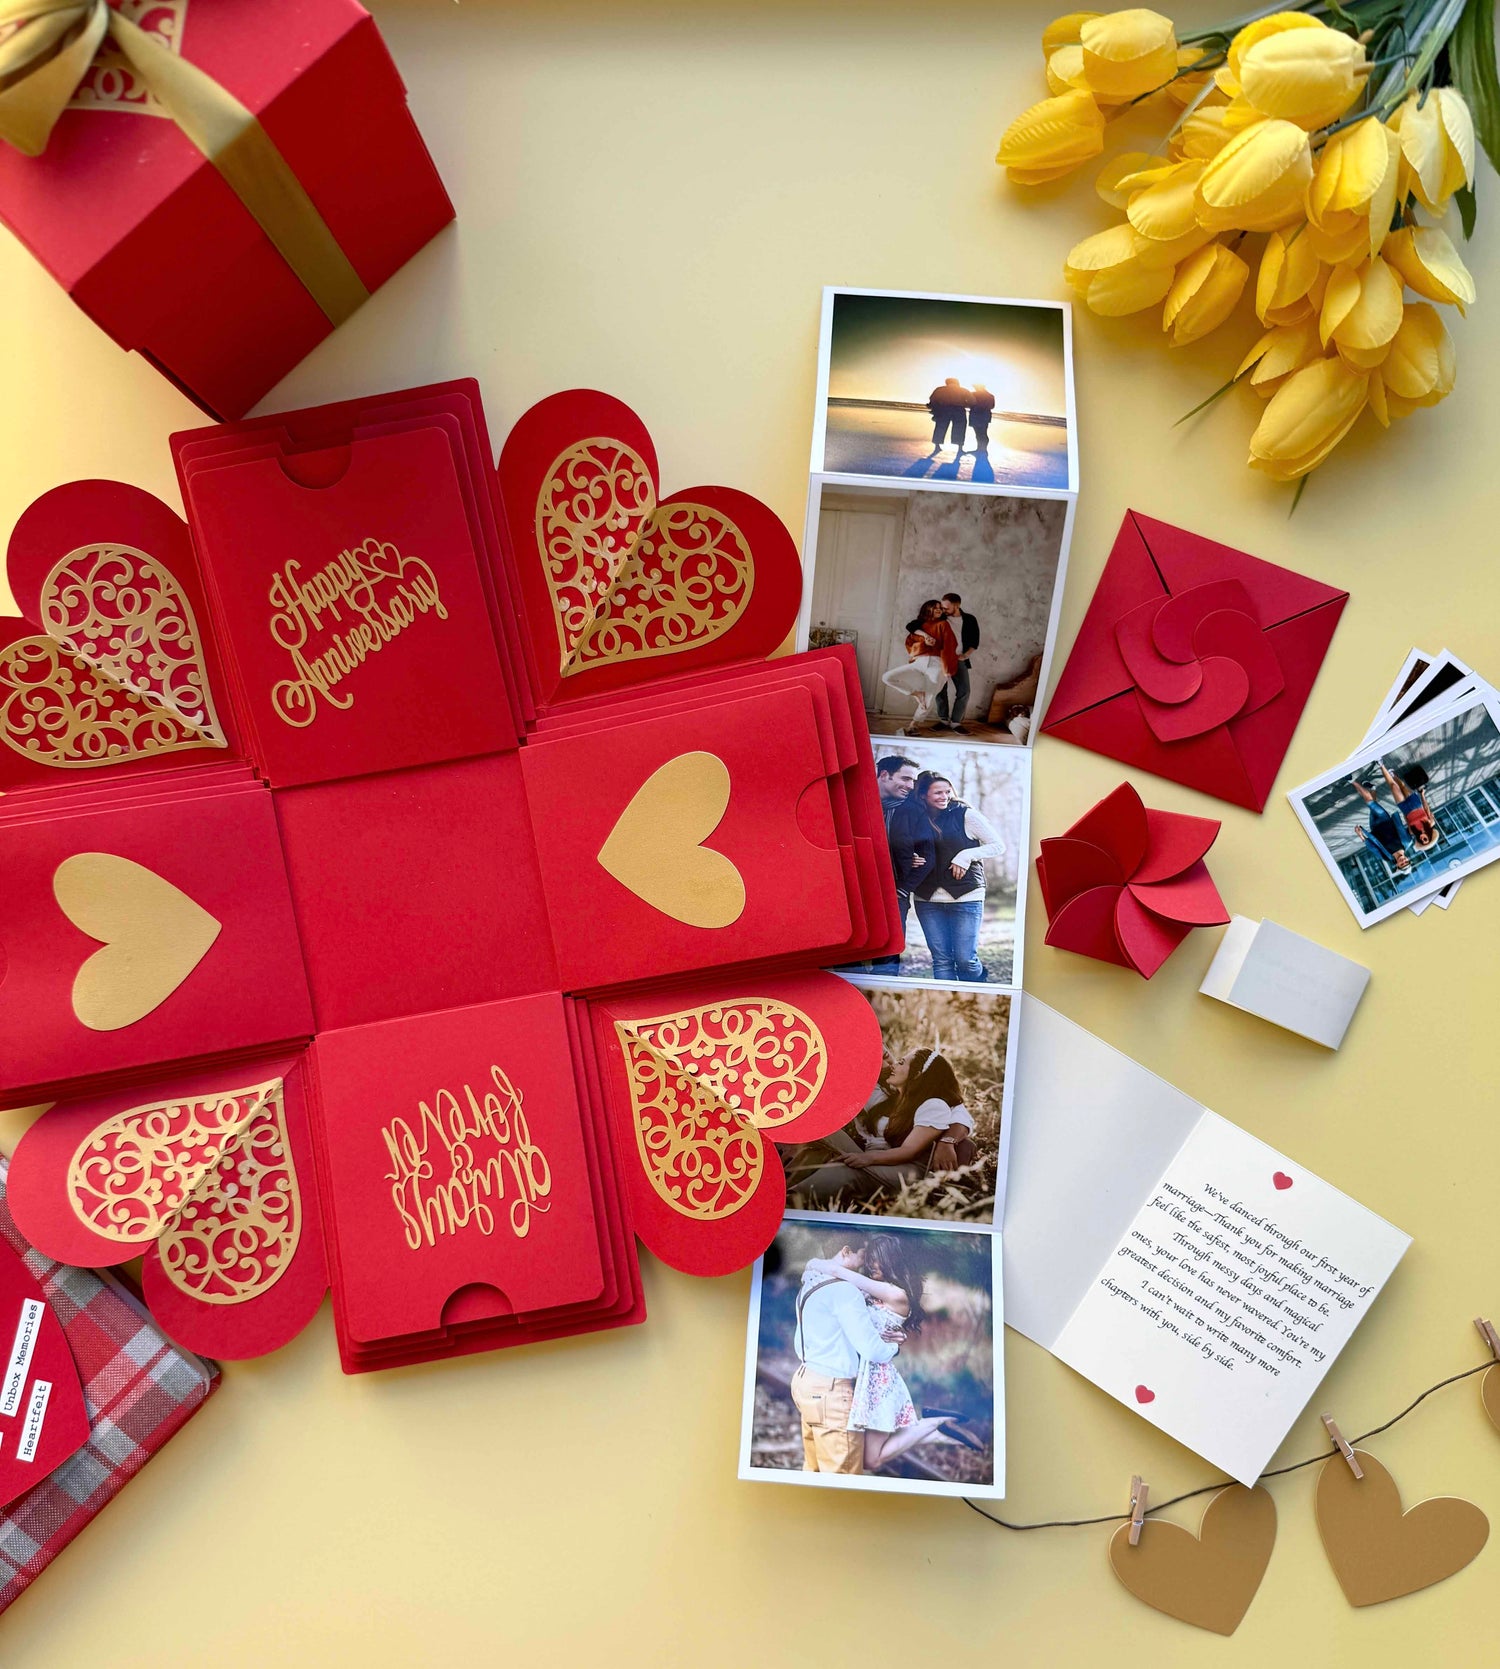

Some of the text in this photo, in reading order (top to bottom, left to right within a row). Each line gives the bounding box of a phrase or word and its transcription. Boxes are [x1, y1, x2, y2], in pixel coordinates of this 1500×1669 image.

[269, 548, 386, 650] Happy
[271, 556, 449, 728] Anniversary
[450, 1141, 474, 1185] &
[1146, 1195, 1330, 1318] feel like the safest, most joyful place to be.
[1172, 1231, 1325, 1333] Through messy days and magical
[1204, 1183, 1375, 1298] We've danced through our first year of
[1239, 1234, 1263, 1250] you
[1256, 1243, 1279, 1259] for
[1277, 1256, 1314, 1285] making
[1313, 1279, 1355, 1310] marriage
[1100, 1278, 1236, 1371] chapters with you, side by side.
[1117, 1246, 1303, 1369] greatest decision and my favorite comfort.
[1131, 1230, 1327, 1363] ones, your love has never wavered. You're my
[1140, 1279, 1281, 1377] I can't wait to write many more
[3, 1303, 39, 1412] Unbox Memories
[23, 1385, 47, 1456] Heartfelt
